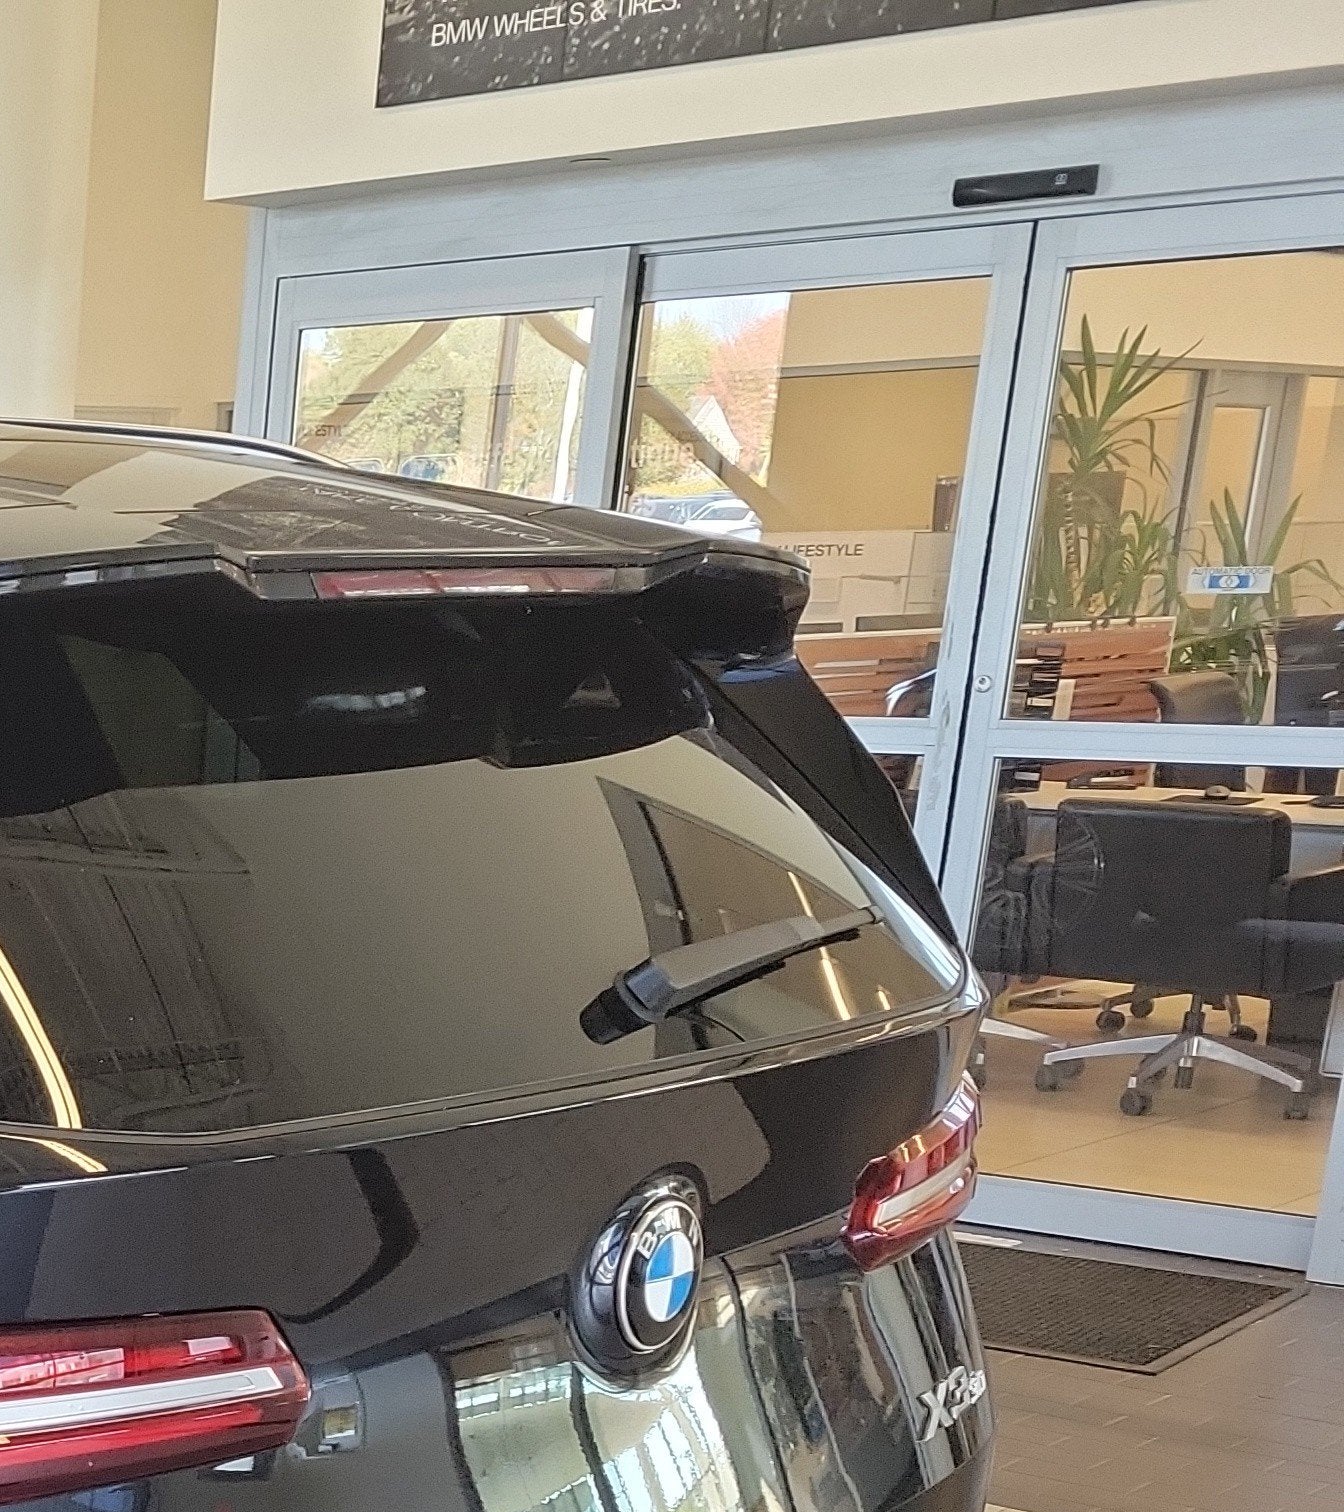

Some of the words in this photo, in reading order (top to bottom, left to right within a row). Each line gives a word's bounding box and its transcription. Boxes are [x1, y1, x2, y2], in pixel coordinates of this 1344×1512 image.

[431, 15, 489, 47] BMW
[493, 2, 585, 37] WHEELS
[589, 0, 607, 23] &
[784, 543, 865, 558] IFESTYLE
